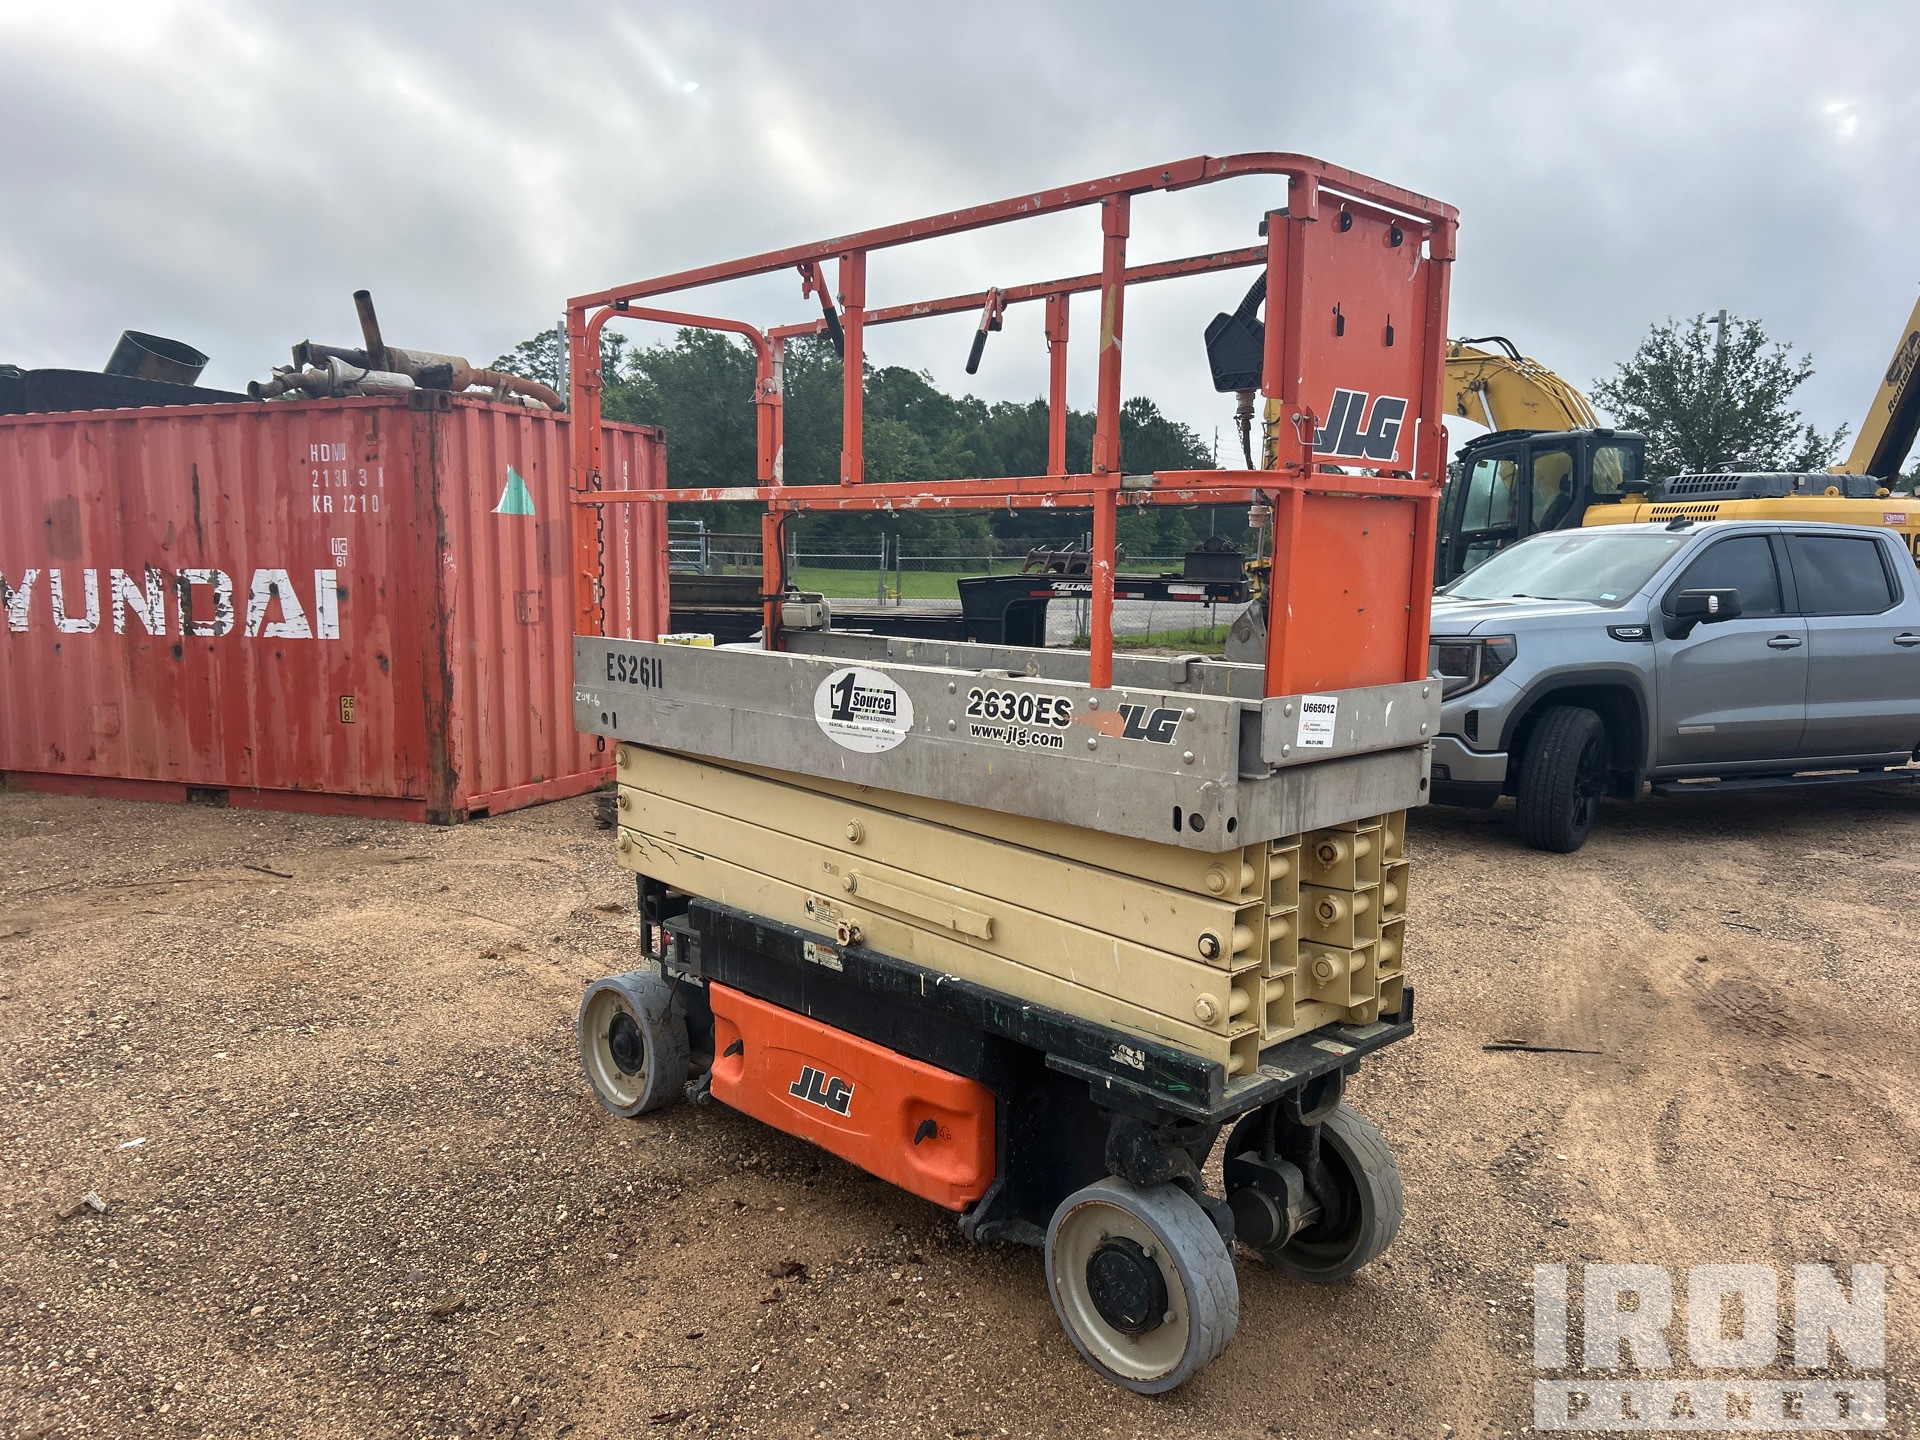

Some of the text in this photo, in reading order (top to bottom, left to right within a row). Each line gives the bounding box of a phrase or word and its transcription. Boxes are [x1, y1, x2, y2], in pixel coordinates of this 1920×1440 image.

[1312, 387, 1409, 462] JLG
[312, 494, 333, 513] KR
[336, 556, 346, 567] 61
[831, 672, 892, 722] 1 Source
[966, 687, 1073, 729] 2630ES
[1303, 703, 1335, 714] U665012
[873, 715, 896, 724] EQUIPMENT
[970, 723, 1064, 749] www.jlg.com
[788, 1065, 855, 1116] JLG
